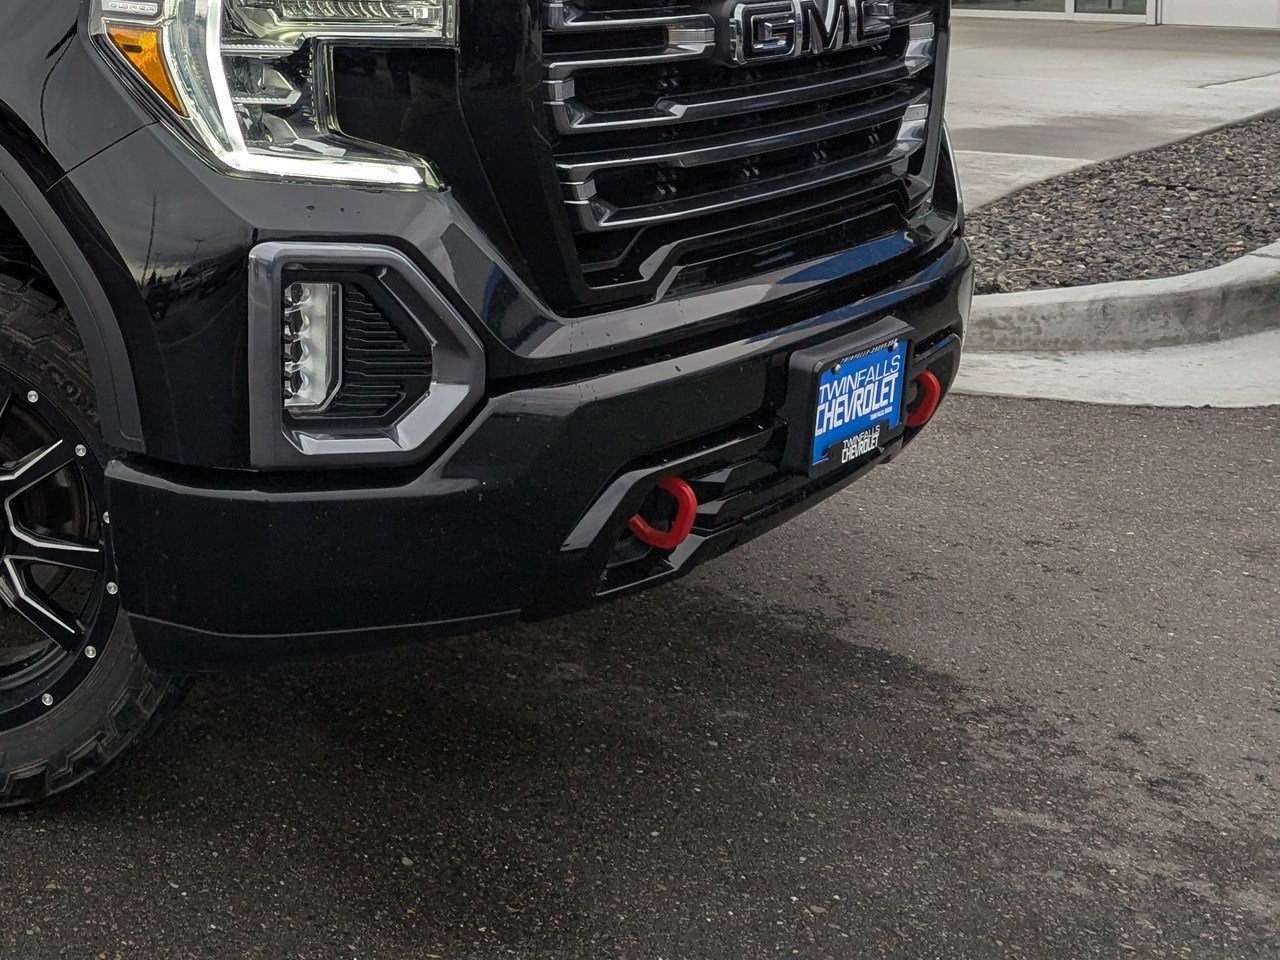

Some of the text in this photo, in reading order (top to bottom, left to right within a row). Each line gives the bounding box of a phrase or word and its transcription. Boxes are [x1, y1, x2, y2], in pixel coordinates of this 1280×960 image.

[819, 355, 901, 403] TWINFALLS
[814, 373, 899, 437] CHEVROLET
[841, 434, 880, 464] CHEVROLET
[843, 425, 880, 449] TWINFALLS
